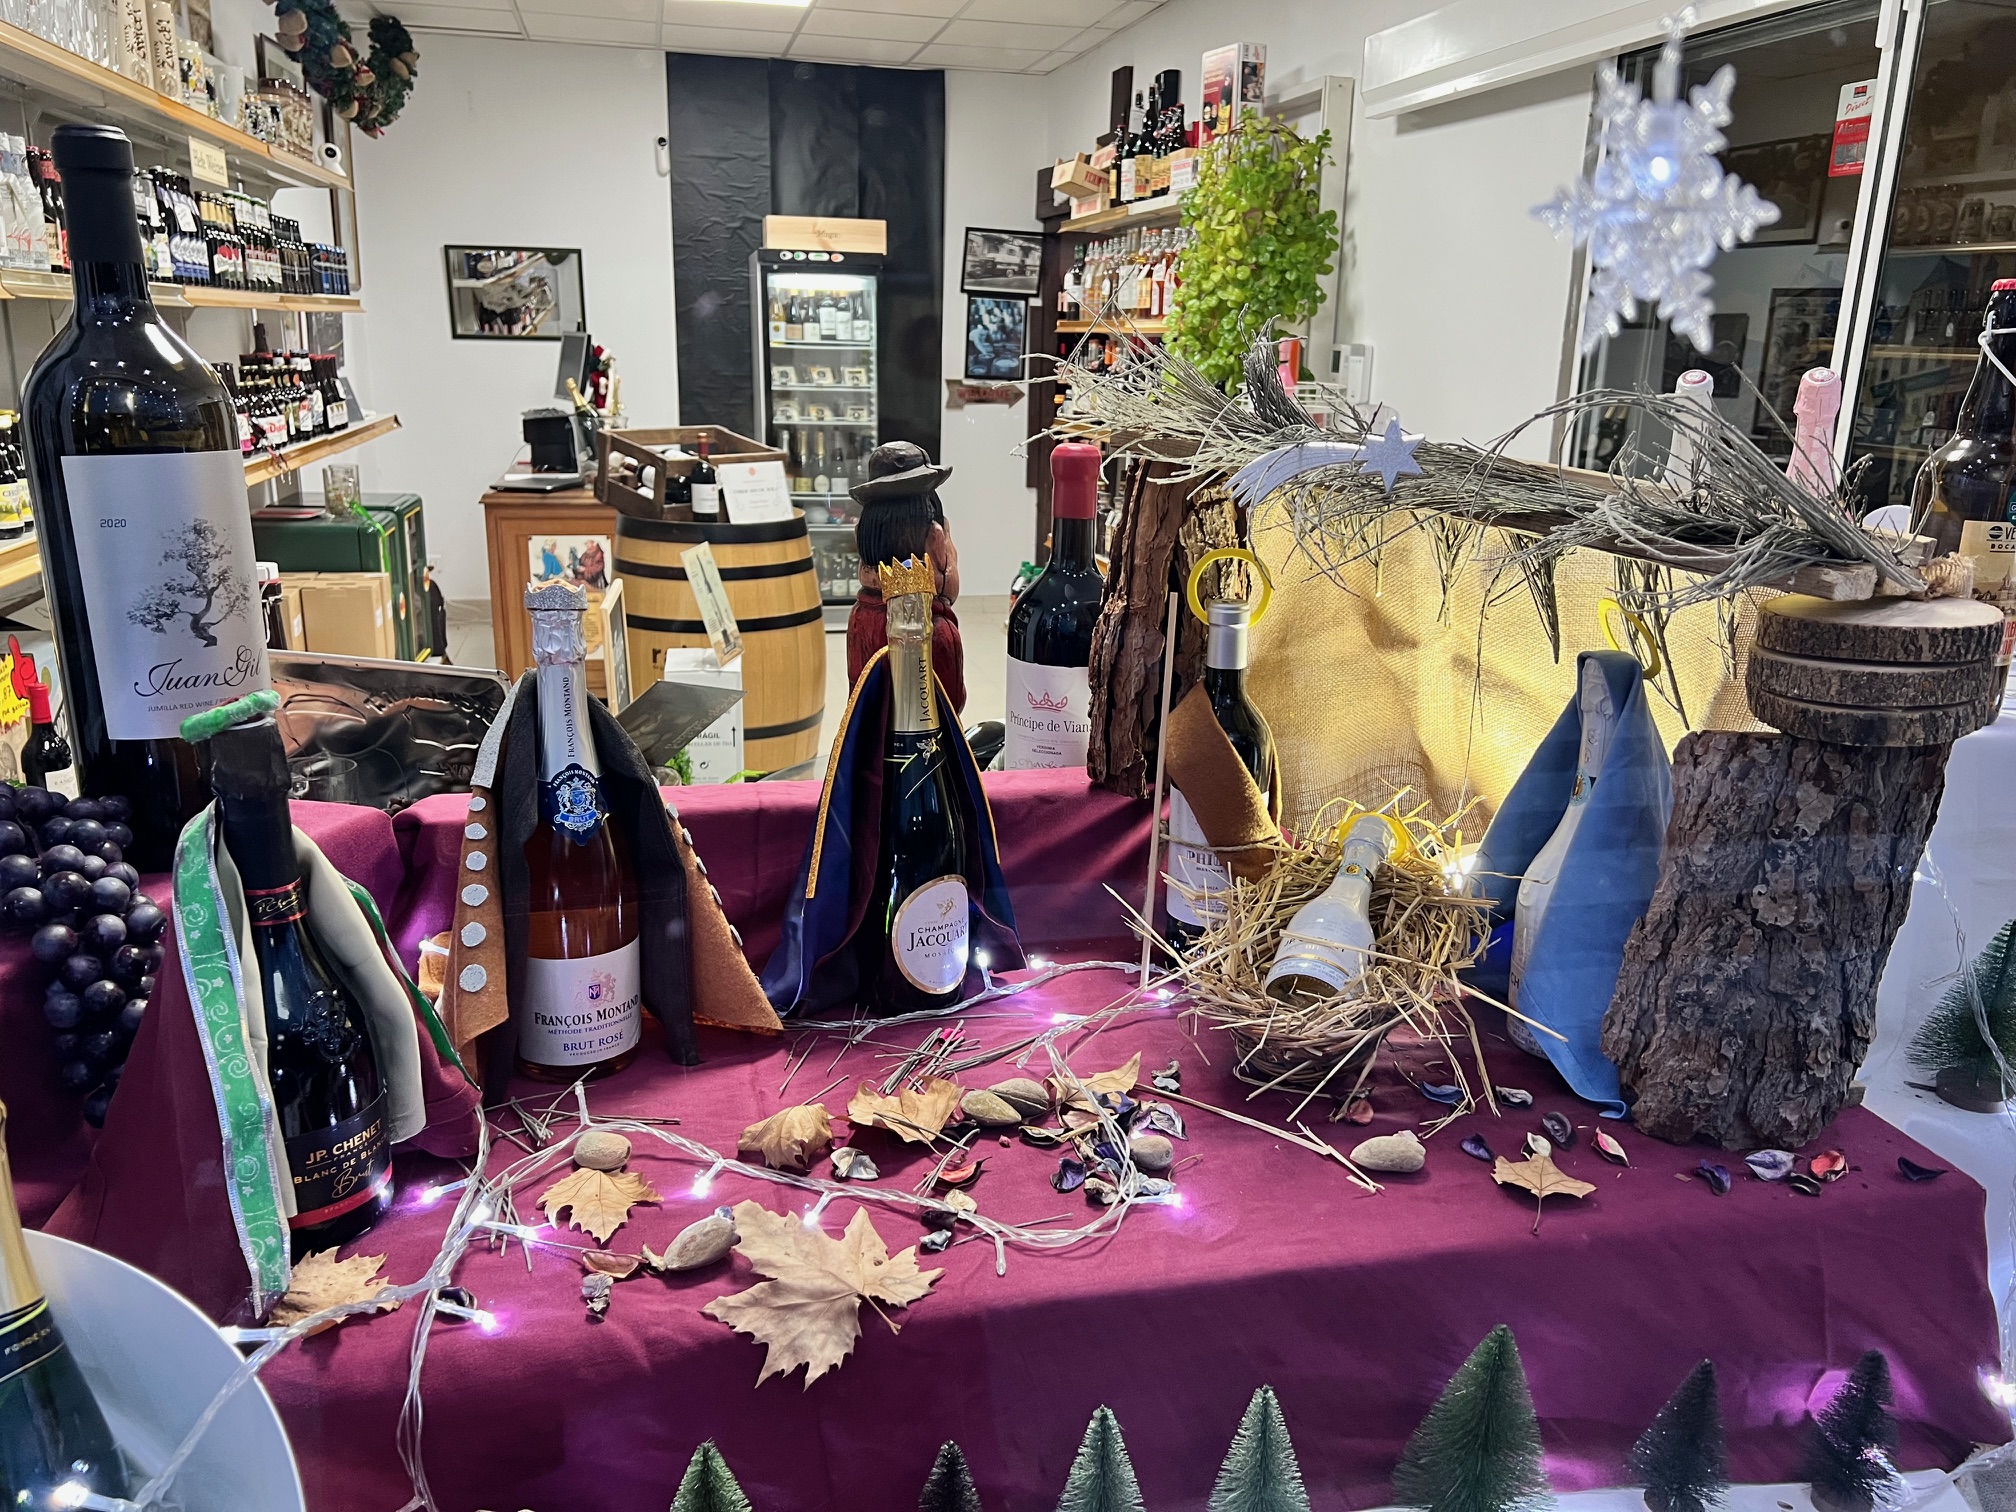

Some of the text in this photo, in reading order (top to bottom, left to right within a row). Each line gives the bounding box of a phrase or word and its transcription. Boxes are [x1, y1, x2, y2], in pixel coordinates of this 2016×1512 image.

[1838, 121, 1869, 134] Alarm
[100, 518, 127, 528] 2020
[133, 644, 263, 698] Juan Gil
[918, 657, 933, 724] JACQUART
[148, 703, 178, 712] JUMILLA
[180, 702, 194, 710] RED
[195, 699, 214, 708] WINE
[562, 676, 575, 758] FRANÇOIS MONTAND
[1010, 710, 1044, 732] Príncipe
[1046, 720, 1060, 732] de
[568, 815, 590, 823] BRUT
[907, 922, 968, 952] JACQUART
[917, 917, 965, 934] CHAMPAGNE
[534, 994, 639, 1029] FRANÇOIS MONTAND
[548, 1012, 633, 1035] MÉTHODE TRADITIONNELLE
[563, 1029, 624, 1052] BRUT ROSÉ
[332, 1118, 381, 1155] CHENET
[293, 1167, 337, 1184] BLANC
[342, 1157, 357, 1169] DE
[331, 1158, 375, 1199] Brut
